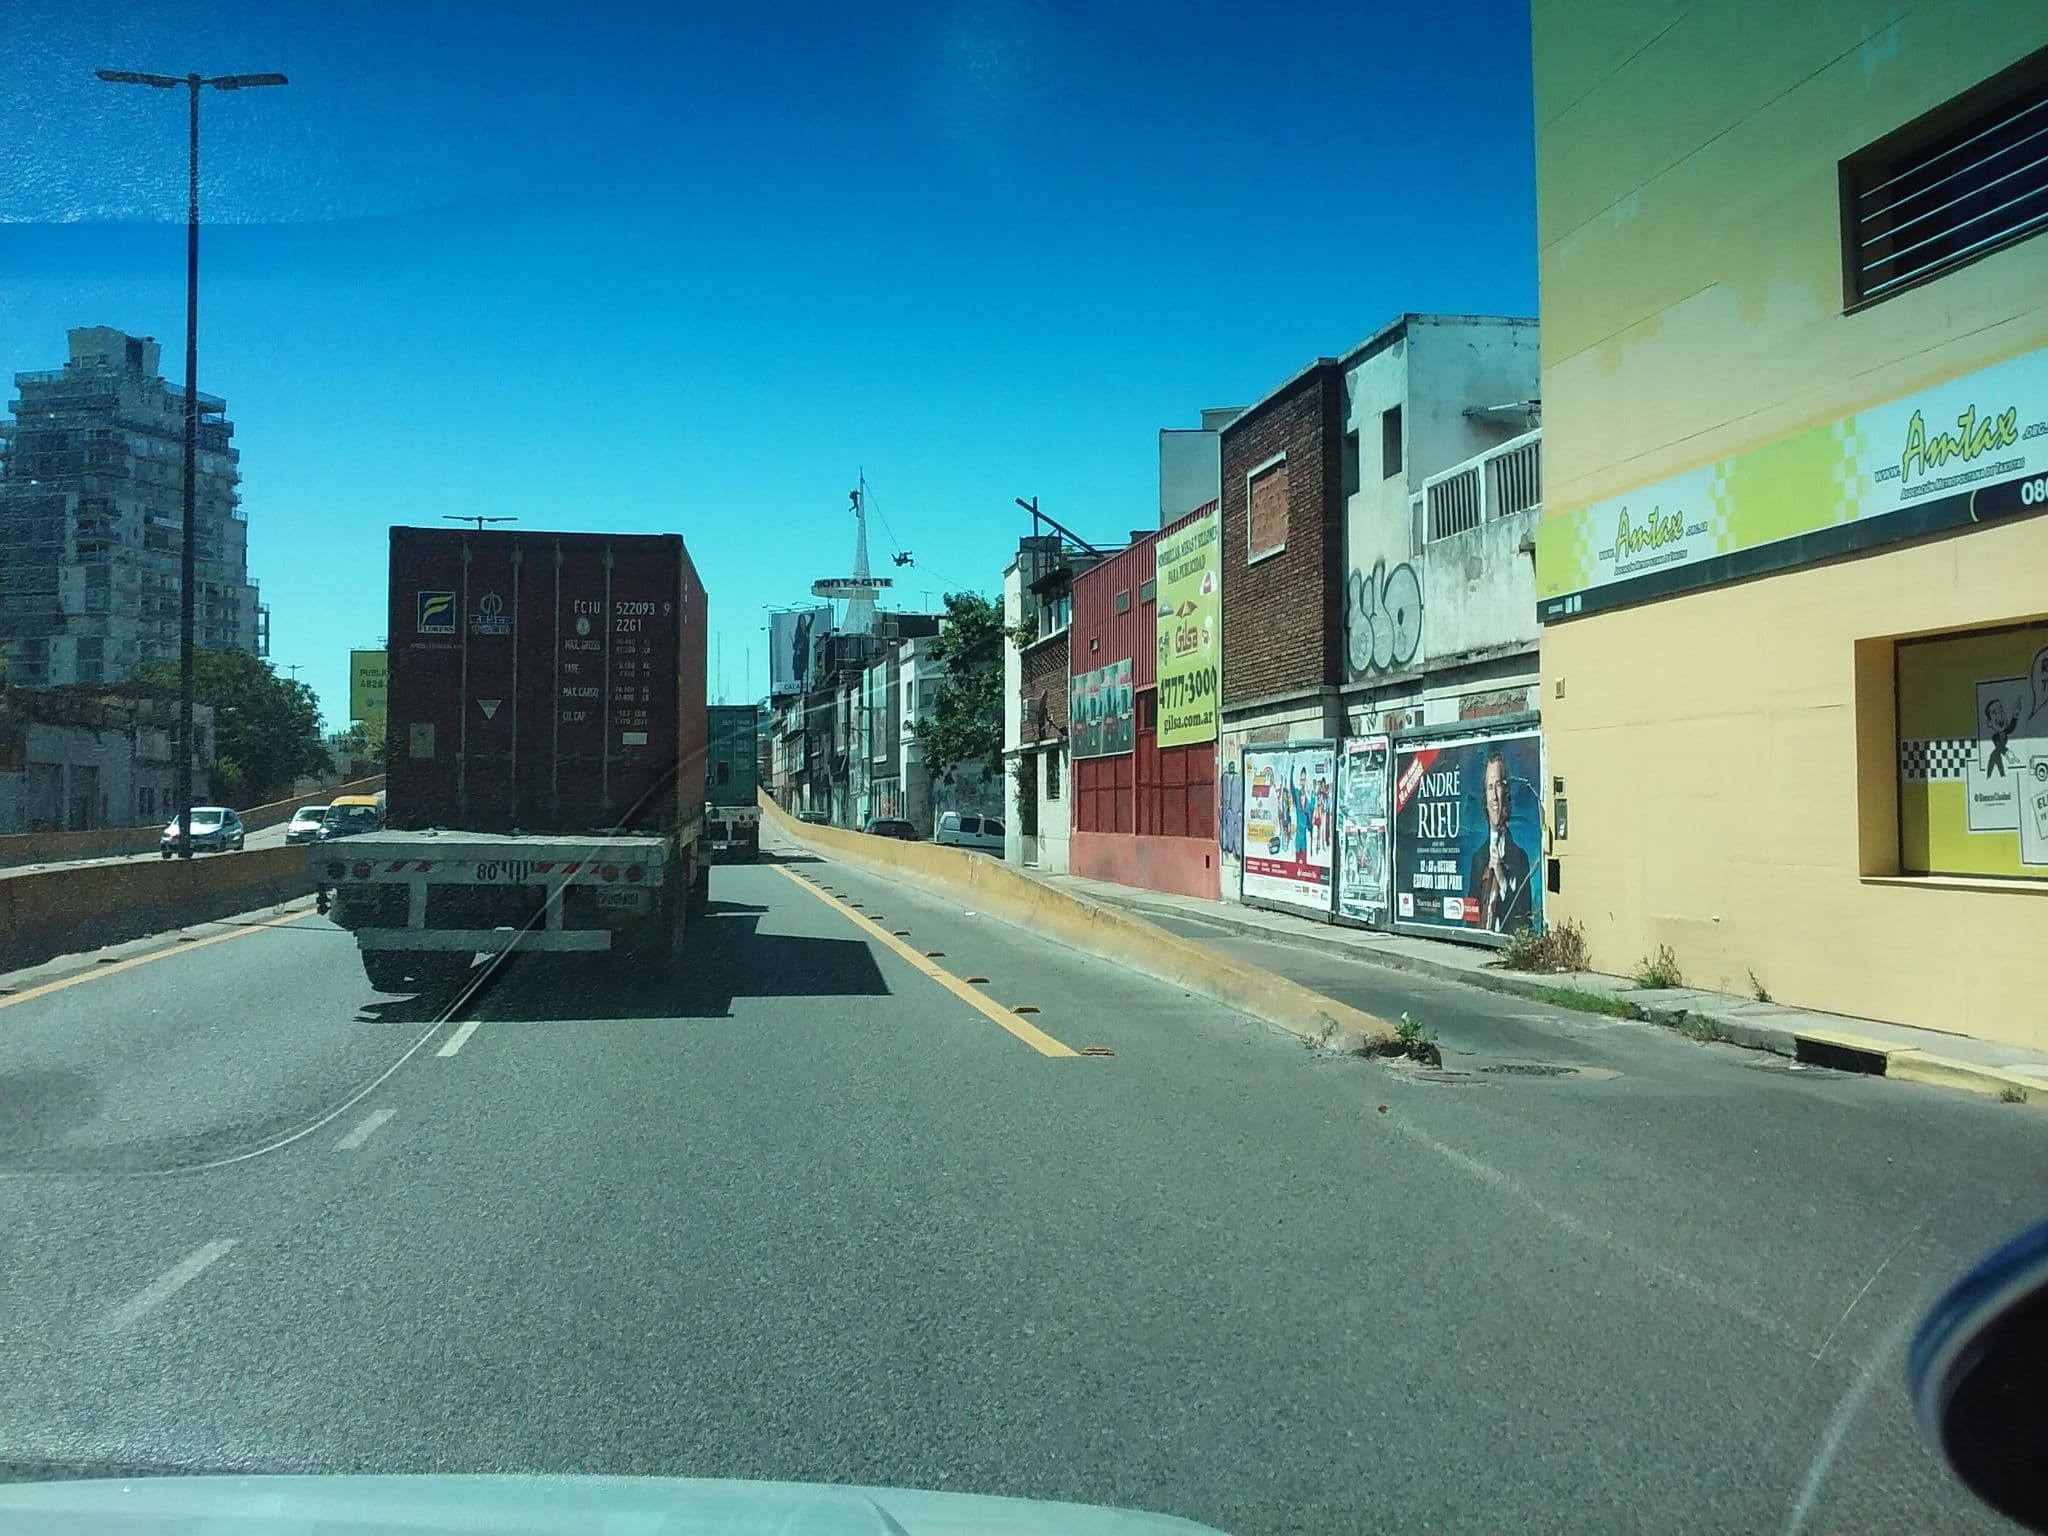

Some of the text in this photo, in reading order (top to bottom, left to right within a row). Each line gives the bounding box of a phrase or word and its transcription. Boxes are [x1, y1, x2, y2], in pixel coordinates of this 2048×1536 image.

[1901, 404, 2018, 483] Amtax
[2021, 476, 2048, 505] 08
[1615, 506, 1684, 563] Amtax
[616, 603, 655, 615] 522093
[1159, 665, 1218, 710] 4777-3000
[1163, 710, 1214, 735] gilsa.com.ar
[1417, 763, 1461, 799] ANDRÉ
[1417, 801, 1461, 839] RIEU
